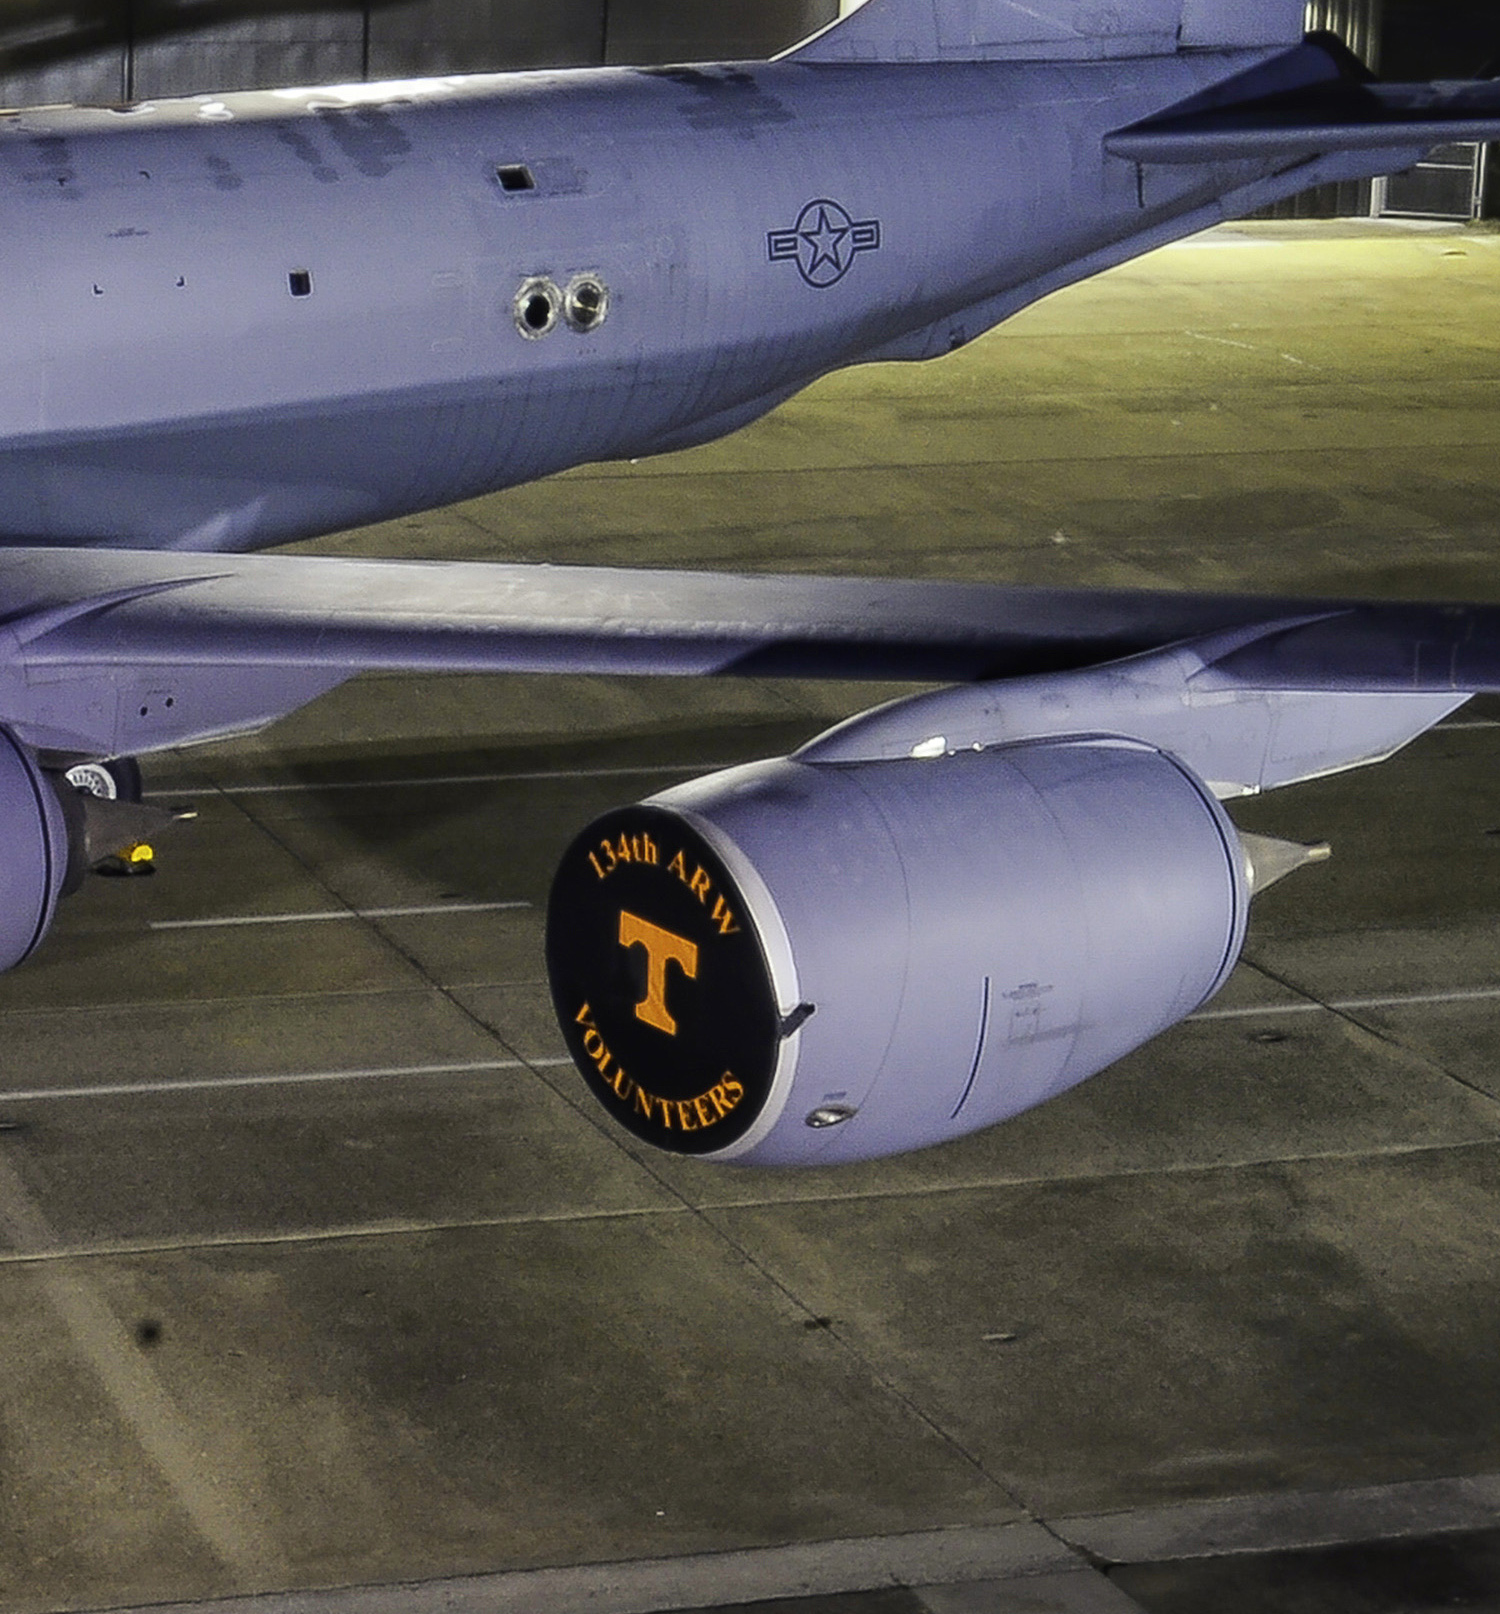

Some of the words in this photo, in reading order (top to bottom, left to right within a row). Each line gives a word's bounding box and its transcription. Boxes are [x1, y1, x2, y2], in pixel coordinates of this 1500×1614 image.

[588, 831, 660, 879] 134th
[667, 848, 741, 935] ARW
[618, 909, 698, 1036] T
[575, 1001, 745, 1131] VOLUNTEERS
